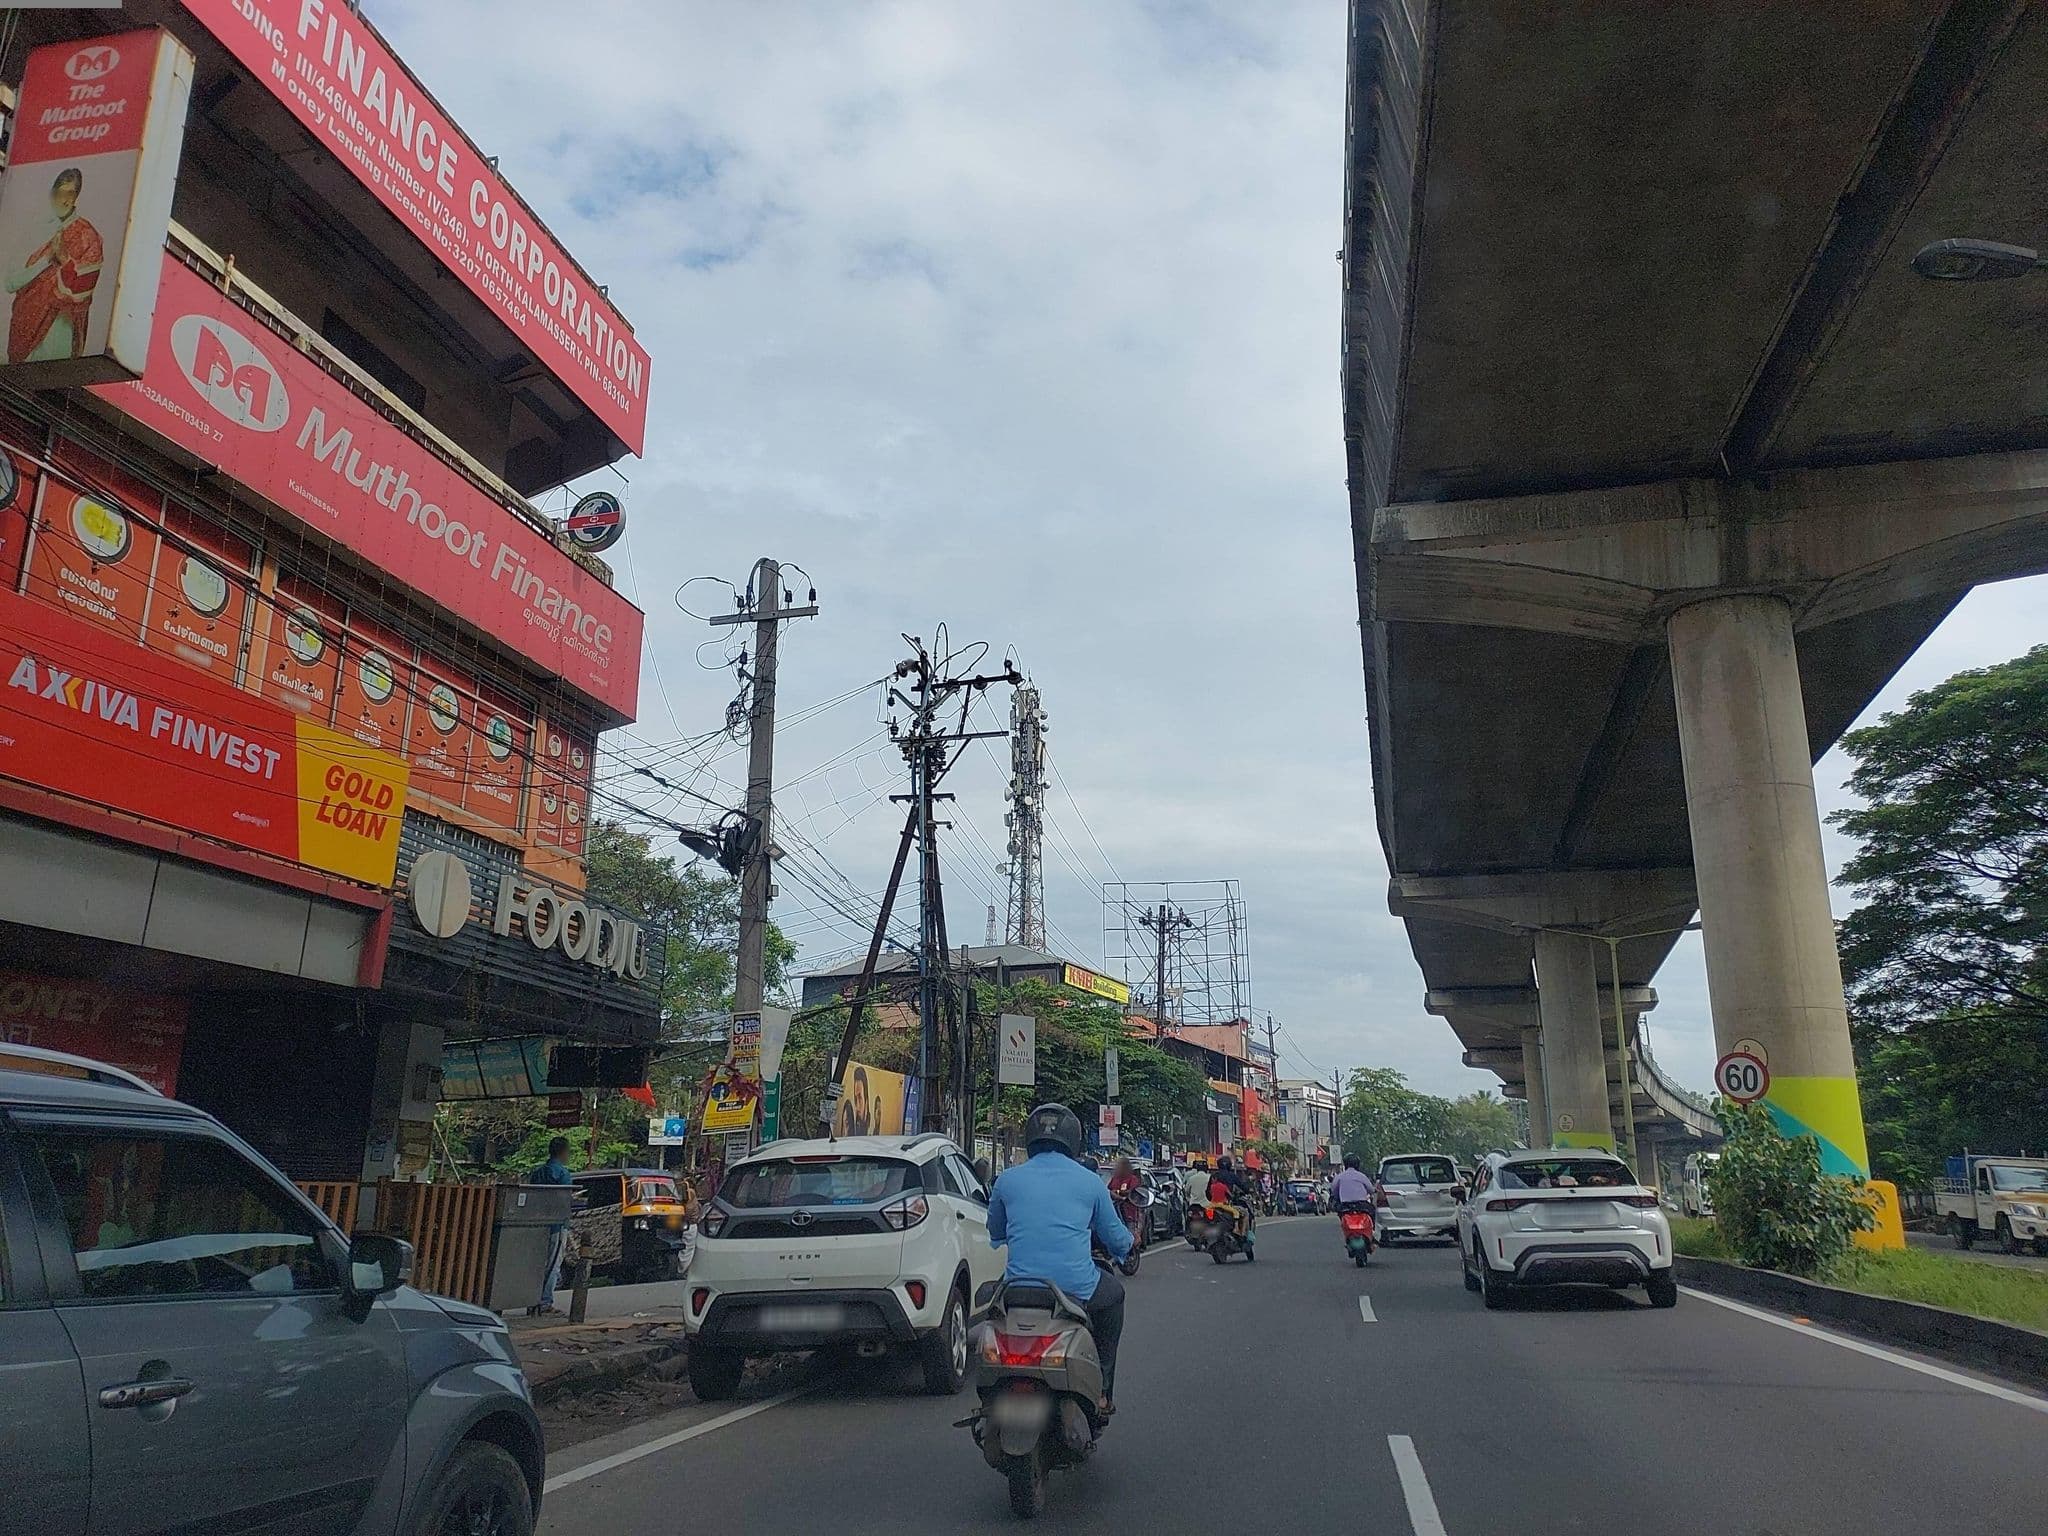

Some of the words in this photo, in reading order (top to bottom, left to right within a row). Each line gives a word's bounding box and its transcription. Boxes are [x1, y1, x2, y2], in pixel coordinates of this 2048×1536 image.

[40, 98, 127, 125] Muthoot
[69, 84, 105, 101] The
[48, 122, 110, 144] Group
[297, 0, 458, 198] FINANCE
[470, 179, 643, 398] CORPORATION
[328, 117, 382, 184] Lending
[383, 173, 431, 230] Licence
[482, 275, 527, 327] 0657464
[378, 139, 426, 199] Number
[603, 376, 630, 414] 683104
[296, 406, 488, 569] Muthoot
[491, 540, 614, 654] Finance
[150, 706, 282, 780] FINVEST
[324, 764, 394, 811] GOLD
[315, 795, 388, 842] LOAN
[1725, 1064, 1759, 1093] 60
